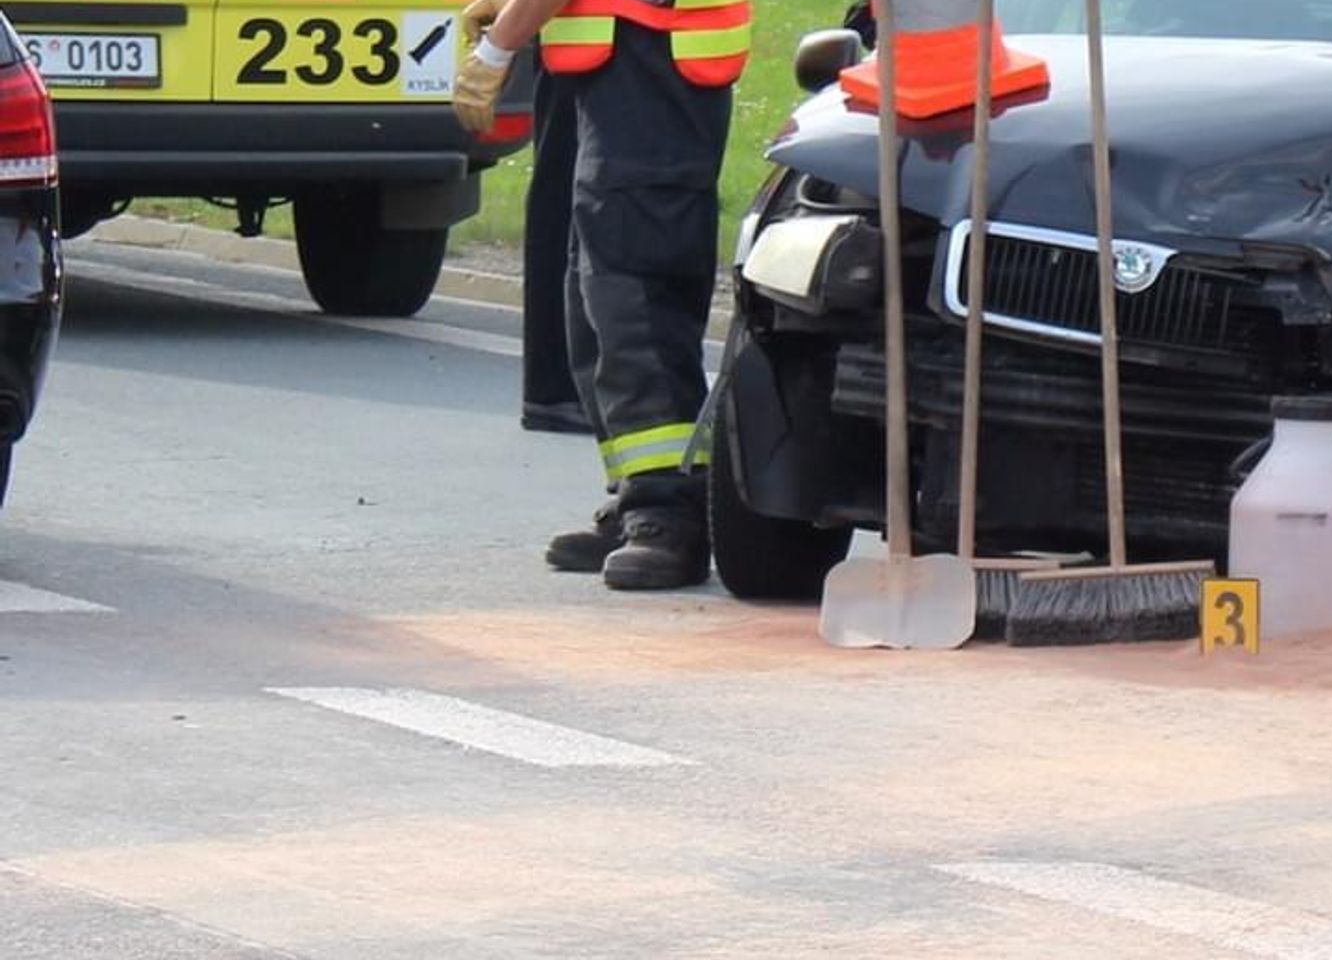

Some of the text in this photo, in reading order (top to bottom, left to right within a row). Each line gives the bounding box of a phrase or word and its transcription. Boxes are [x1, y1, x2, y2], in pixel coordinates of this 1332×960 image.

[67, 40, 142, 71] 0103
[236, 17, 401, 86] 233
[1213, 591, 1245, 646] 3
